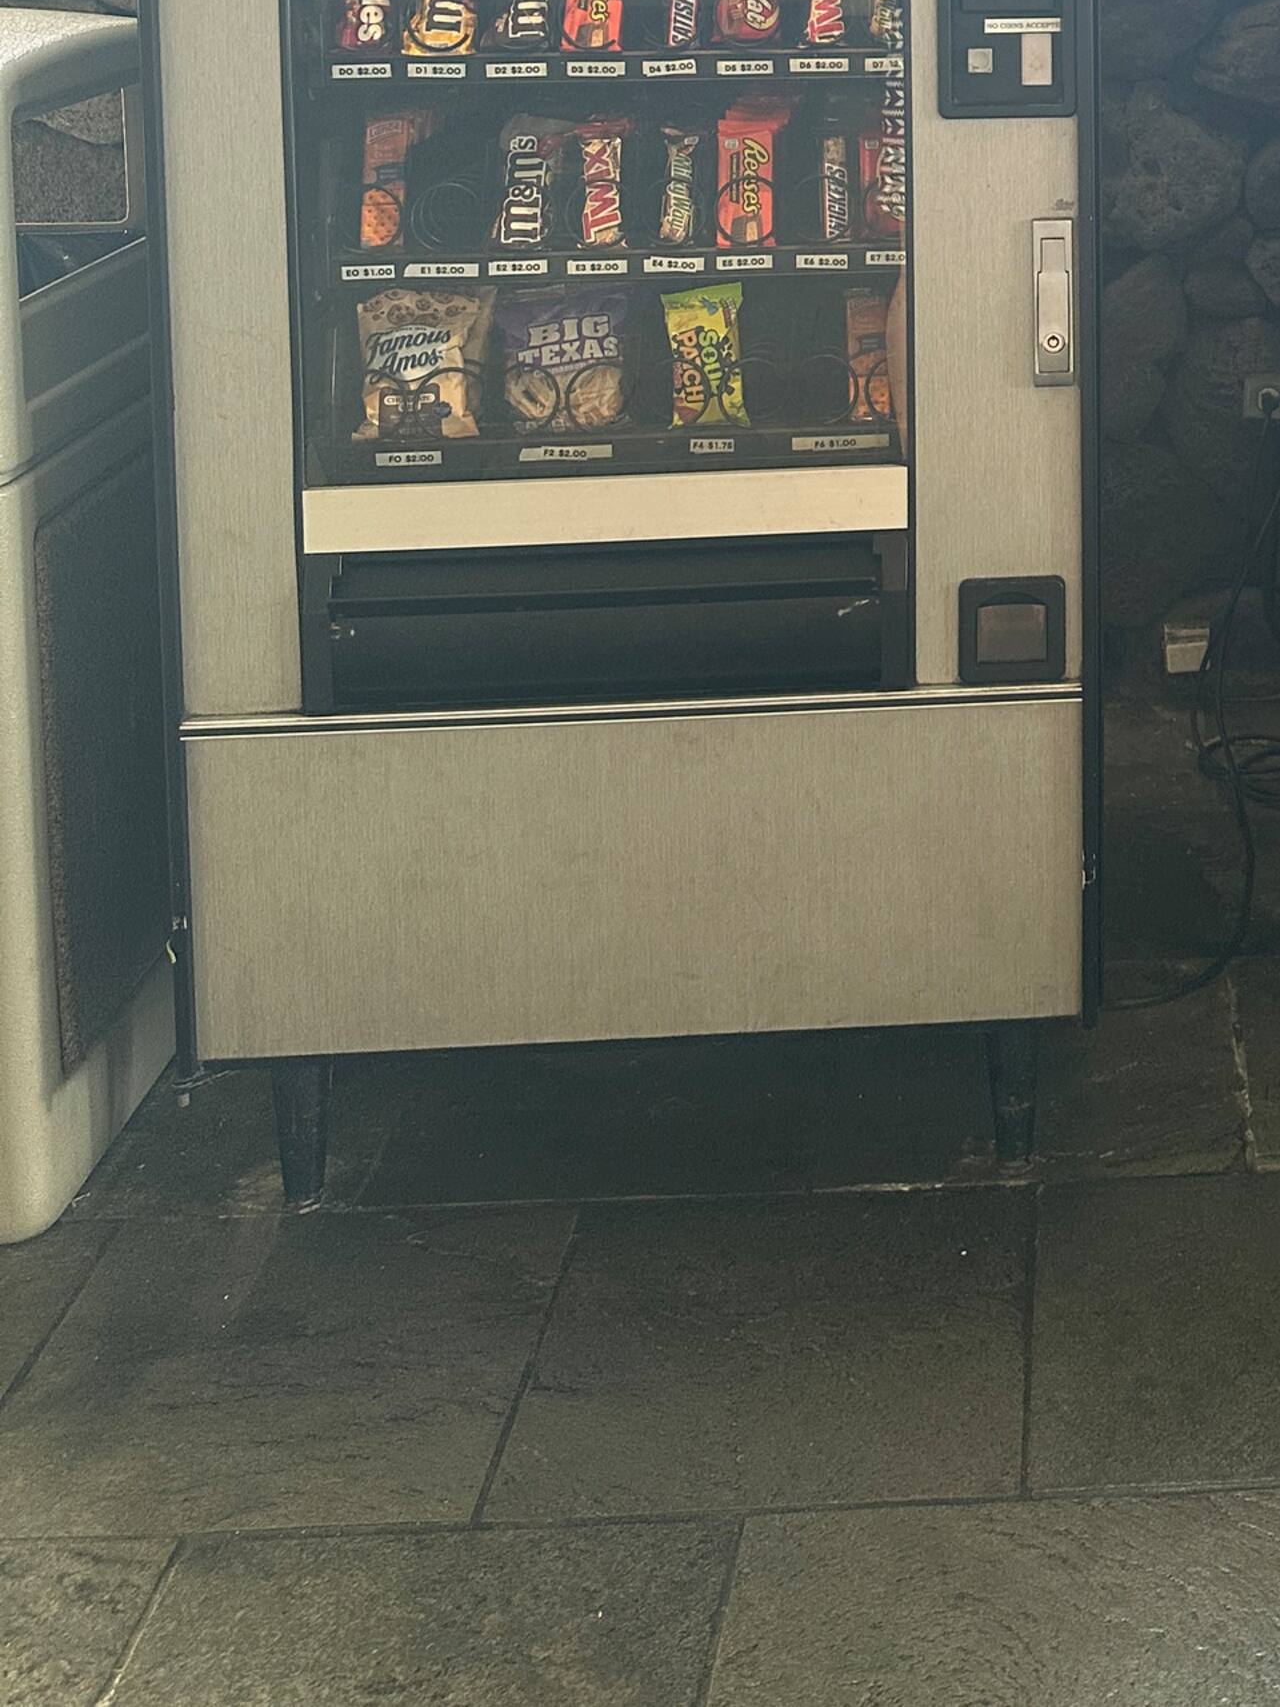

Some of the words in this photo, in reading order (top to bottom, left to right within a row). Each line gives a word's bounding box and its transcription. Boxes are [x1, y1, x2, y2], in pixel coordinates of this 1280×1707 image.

[588, 65, 616, 74] $2.00
[665, 62, 694, 71] $2.00
[740, 63, 769, 72] $2.00
[815, 61, 844, 69] $2.00
[357, 67, 386, 75] $2.00
[432, 67, 461, 75] $2.00
[511, 66, 540, 74] $2.00
[667, 260, 696, 270] $2.00
[737, 258, 765, 267] $2.00
[819, 258, 847, 267] $2.00
[364, 267, 393, 276] $1.00
[435, 266, 464, 275] $2.00
[511, 263, 541, 272] $2.00
[590, 263, 619, 272] $2.00
[528, 314, 610, 347] BIG
[366, 328, 452, 363] Famous
[518, 336, 619, 368] TEXAS
[370, 351, 442, 385] Amos
[708, 441, 733, 449] $1.75
[405, 453, 434, 463] $2.00
[559, 449, 588, 459] $2.00
